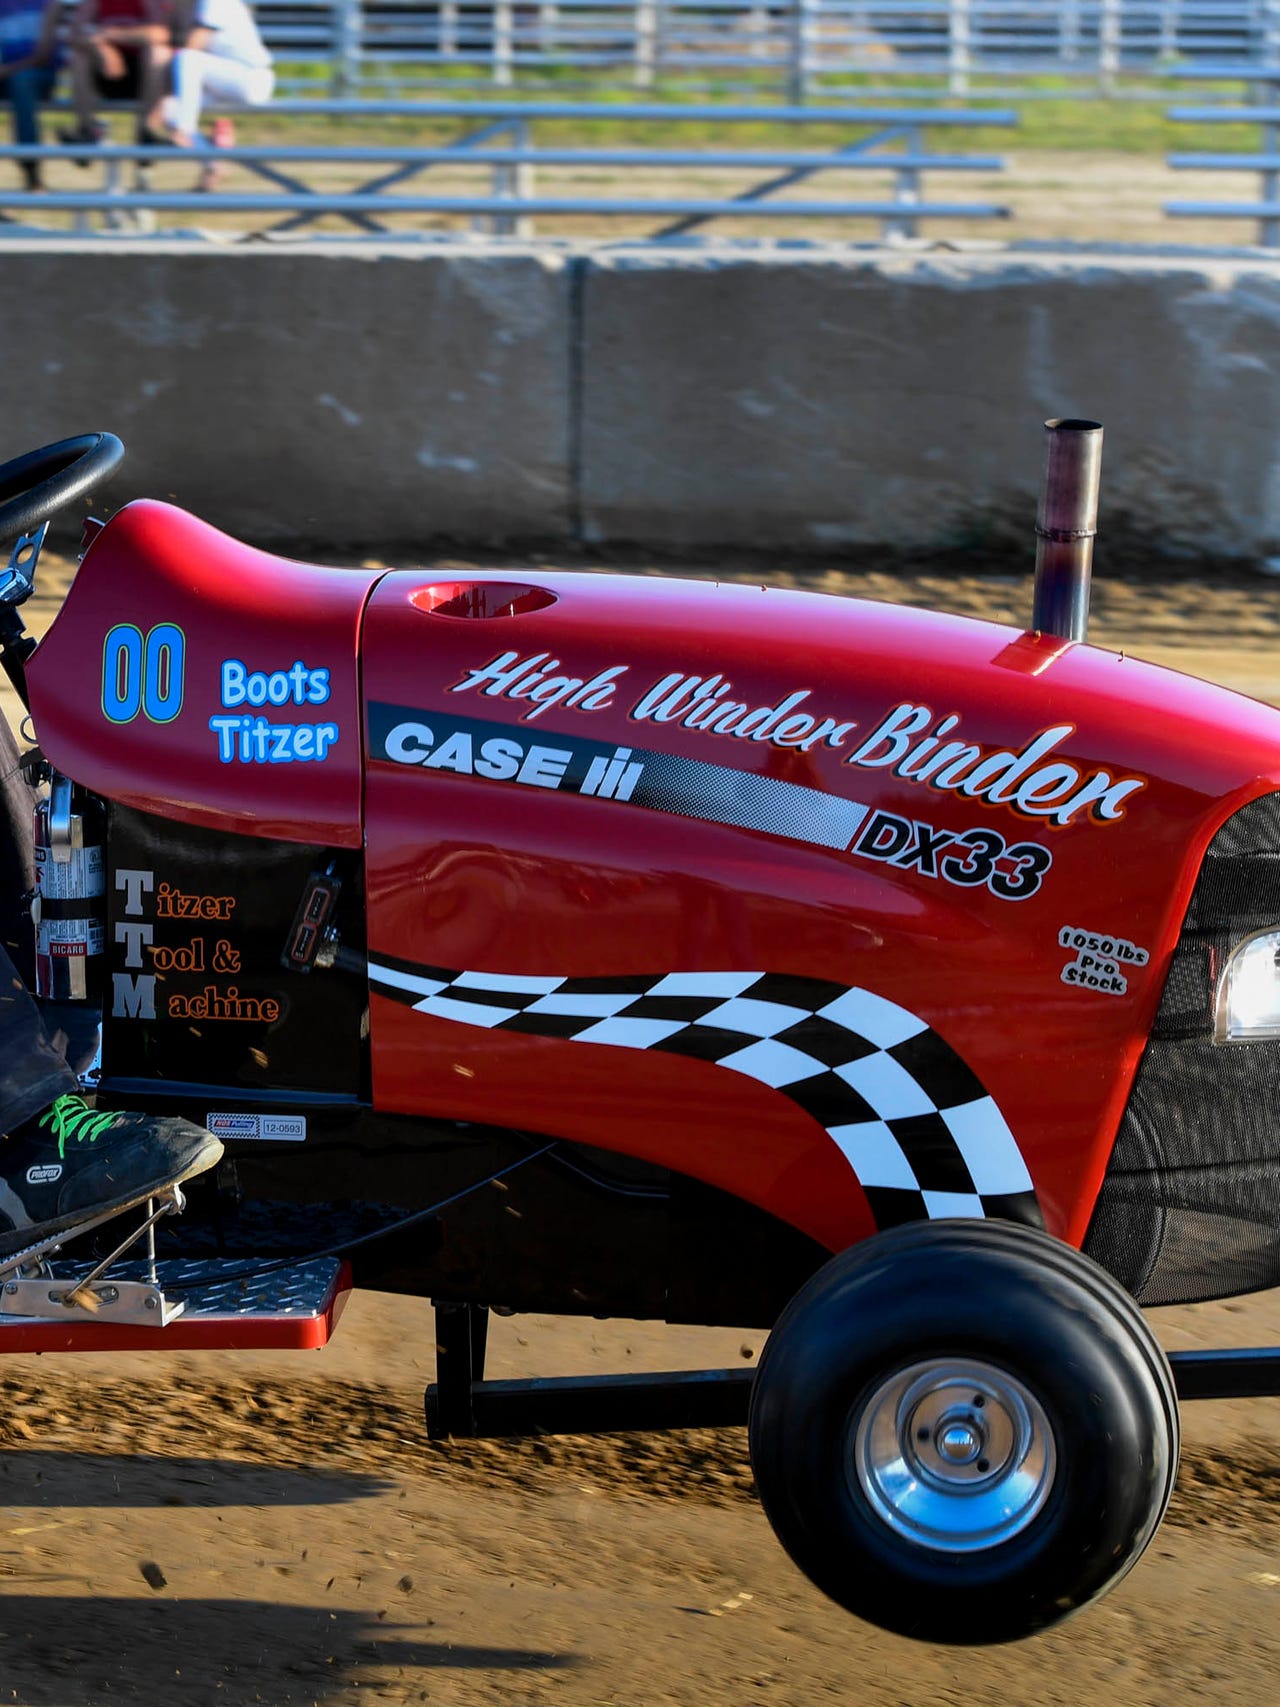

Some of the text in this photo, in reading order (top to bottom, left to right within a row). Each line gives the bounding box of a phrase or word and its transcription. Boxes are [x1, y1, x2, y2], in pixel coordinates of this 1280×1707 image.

[101, 622, 185, 724] 00
[221, 660, 329, 707] Boots
[210, 716, 337, 762] Titzer
[384, 721, 574, 790] CASE
[448, 650, 1146, 826] High Winder Binder
[852, 808, 1053, 900] DX33
[212, 939, 241, 973] &
[1080, 955, 1116, 975] Pro
[1065, 967, 1123, 992] Stock
[265, 1123, 301, 1133] 12-0593
